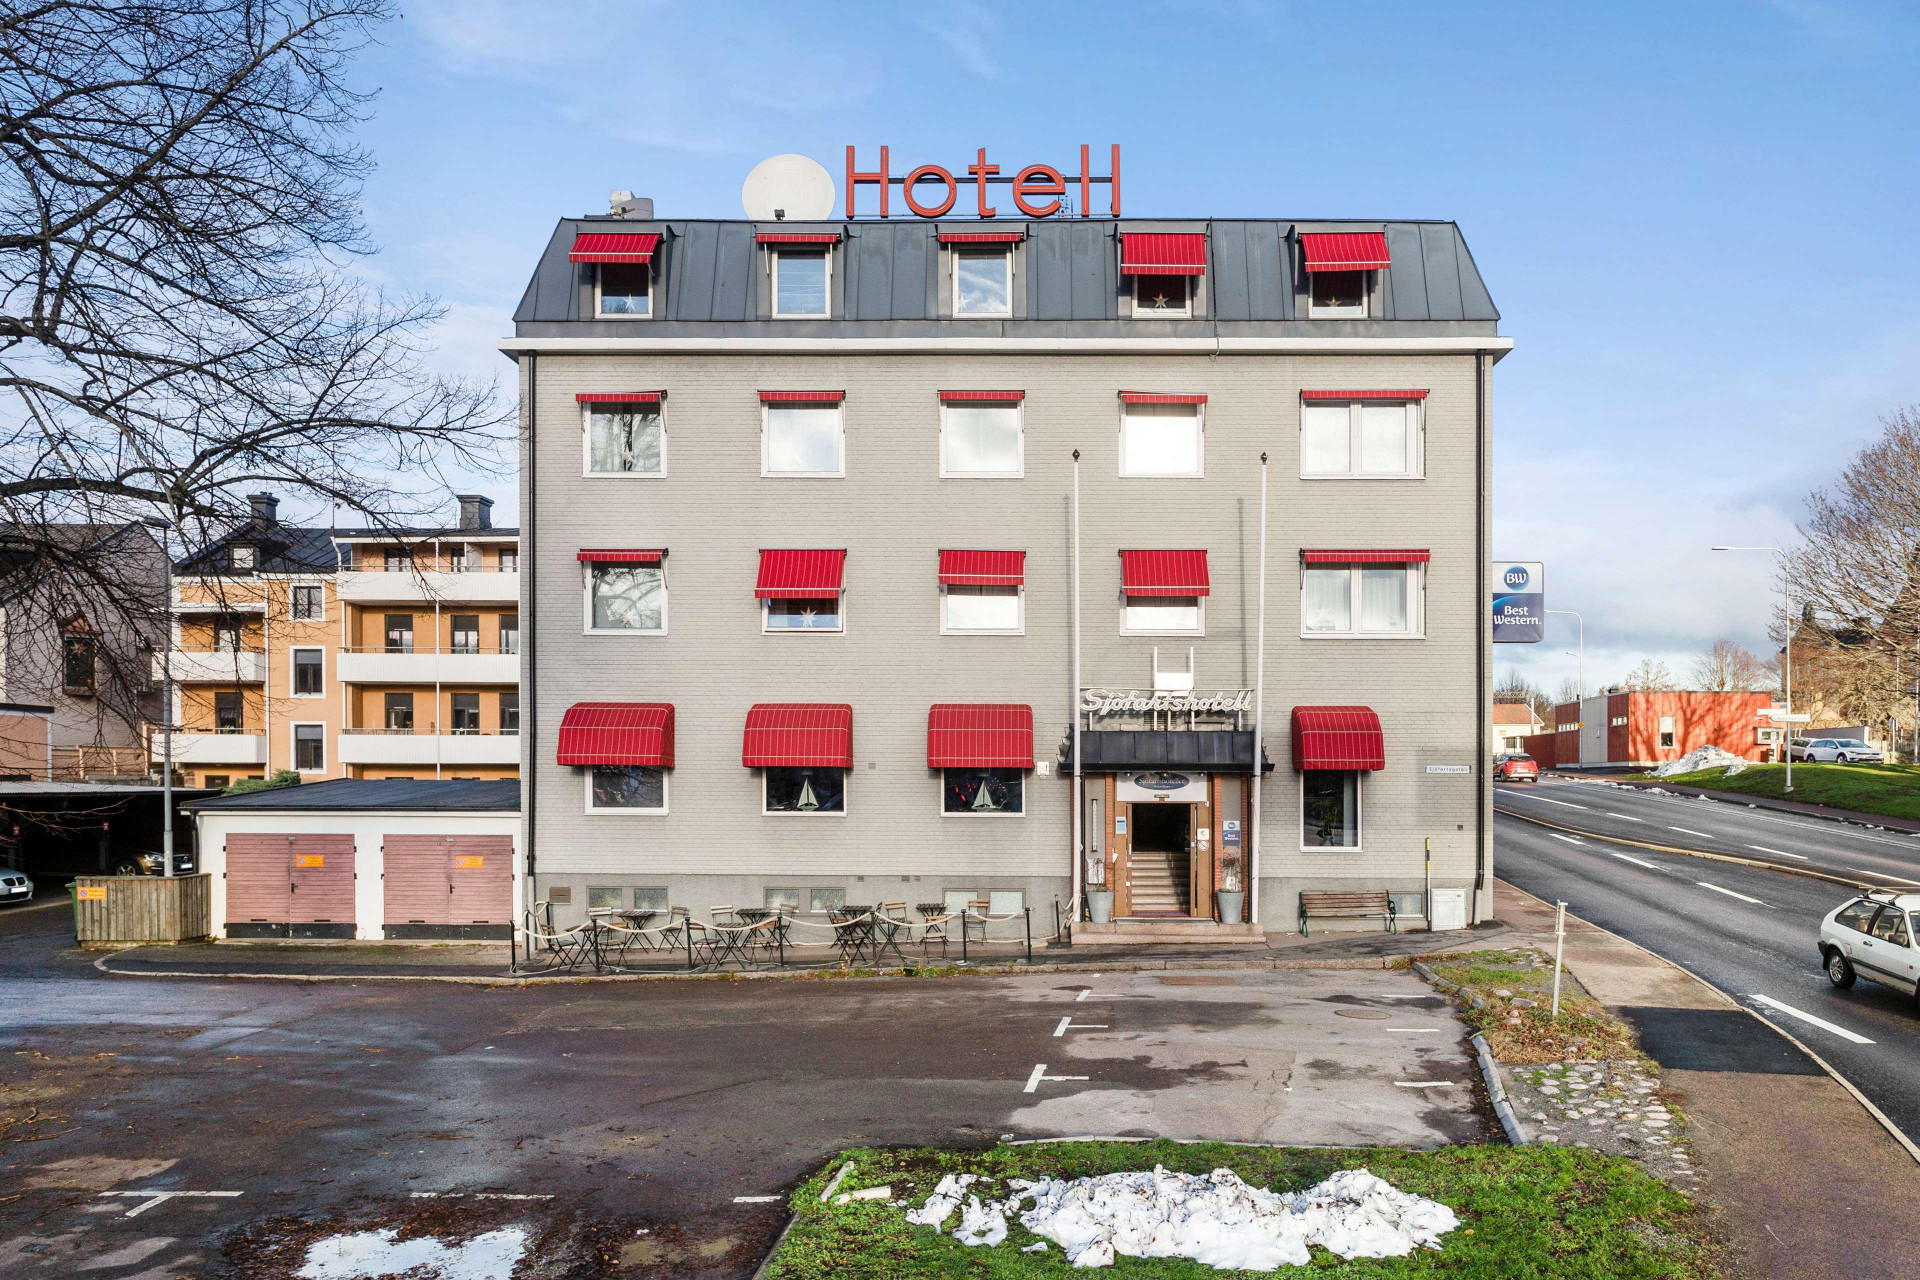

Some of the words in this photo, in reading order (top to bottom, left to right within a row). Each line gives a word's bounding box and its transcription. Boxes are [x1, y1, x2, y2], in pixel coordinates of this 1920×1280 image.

[846, 144, 1120, 218] Hotell
[1506, 573, 1527, 584] BW
[1504, 605, 1529, 615] Best
[1080, 688, 1253, 715] Sjöfartshotell
